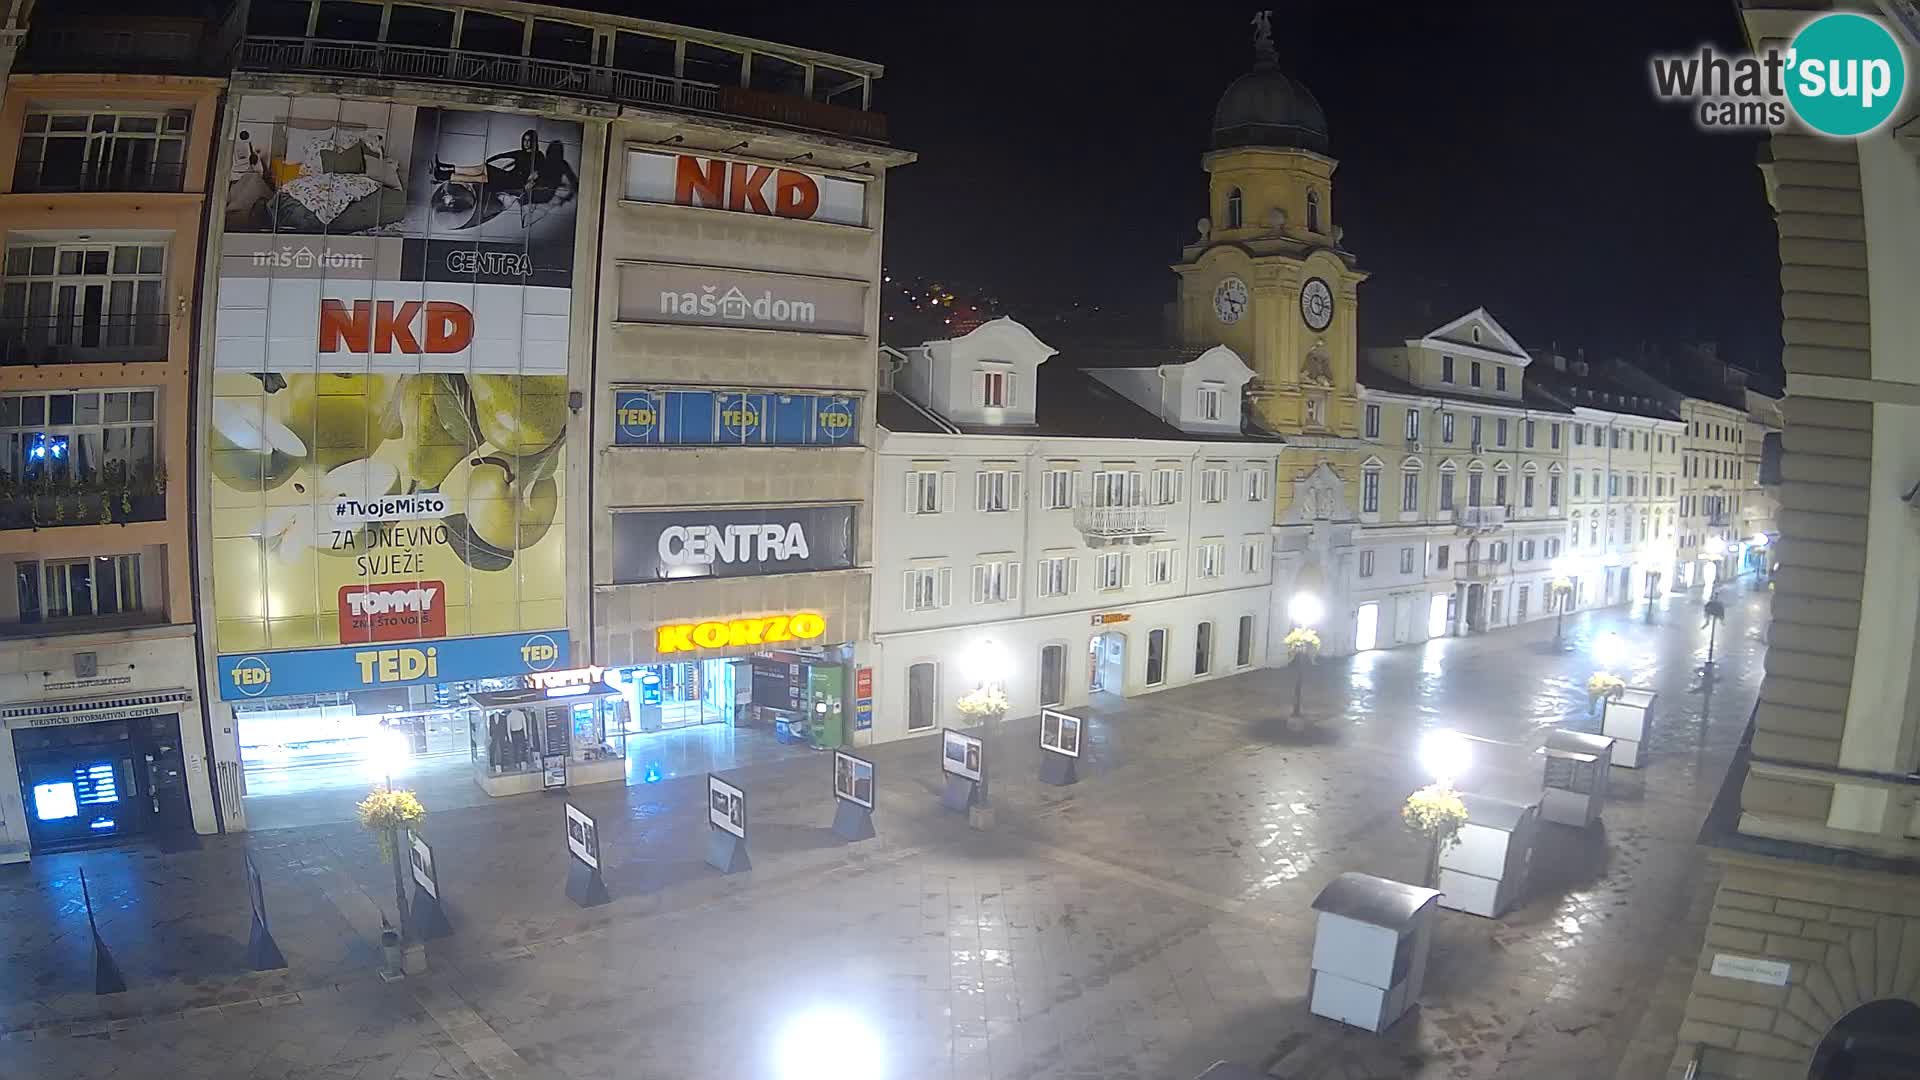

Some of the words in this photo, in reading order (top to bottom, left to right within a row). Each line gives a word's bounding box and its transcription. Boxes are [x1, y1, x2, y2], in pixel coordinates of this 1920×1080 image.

[675, 155, 819, 219] NKD
[252, 246, 292, 267] naš
[318, 248, 363, 268] dom
[446, 250, 533, 277] CENTRA
[660, 285, 717, 316] naš
[752, 290, 816, 323] dom
[319, 299, 475, 354] NKD
[618, 409, 656, 425] TEDi
[722, 410, 759, 427] TEDi
[819, 412, 852, 427] TEDi
[336, 498, 444, 517] #TvojeMisto
[331, 530, 355, 550] ZA
[365, 525, 448, 549] DNEVNO
[658, 522, 809, 564] CENTRA
[357, 549, 425, 576] SVJEŽE
[346, 588, 437, 616] TOMMY
[655, 613, 825, 653] KORZO
[521, 642, 559, 661] TEDi
[231, 667, 271, 686] TEDi
[355, 647, 438, 684] TEDi
[531, 665, 605, 689] TOMMY
[130, 707, 160, 717] CENTAR
